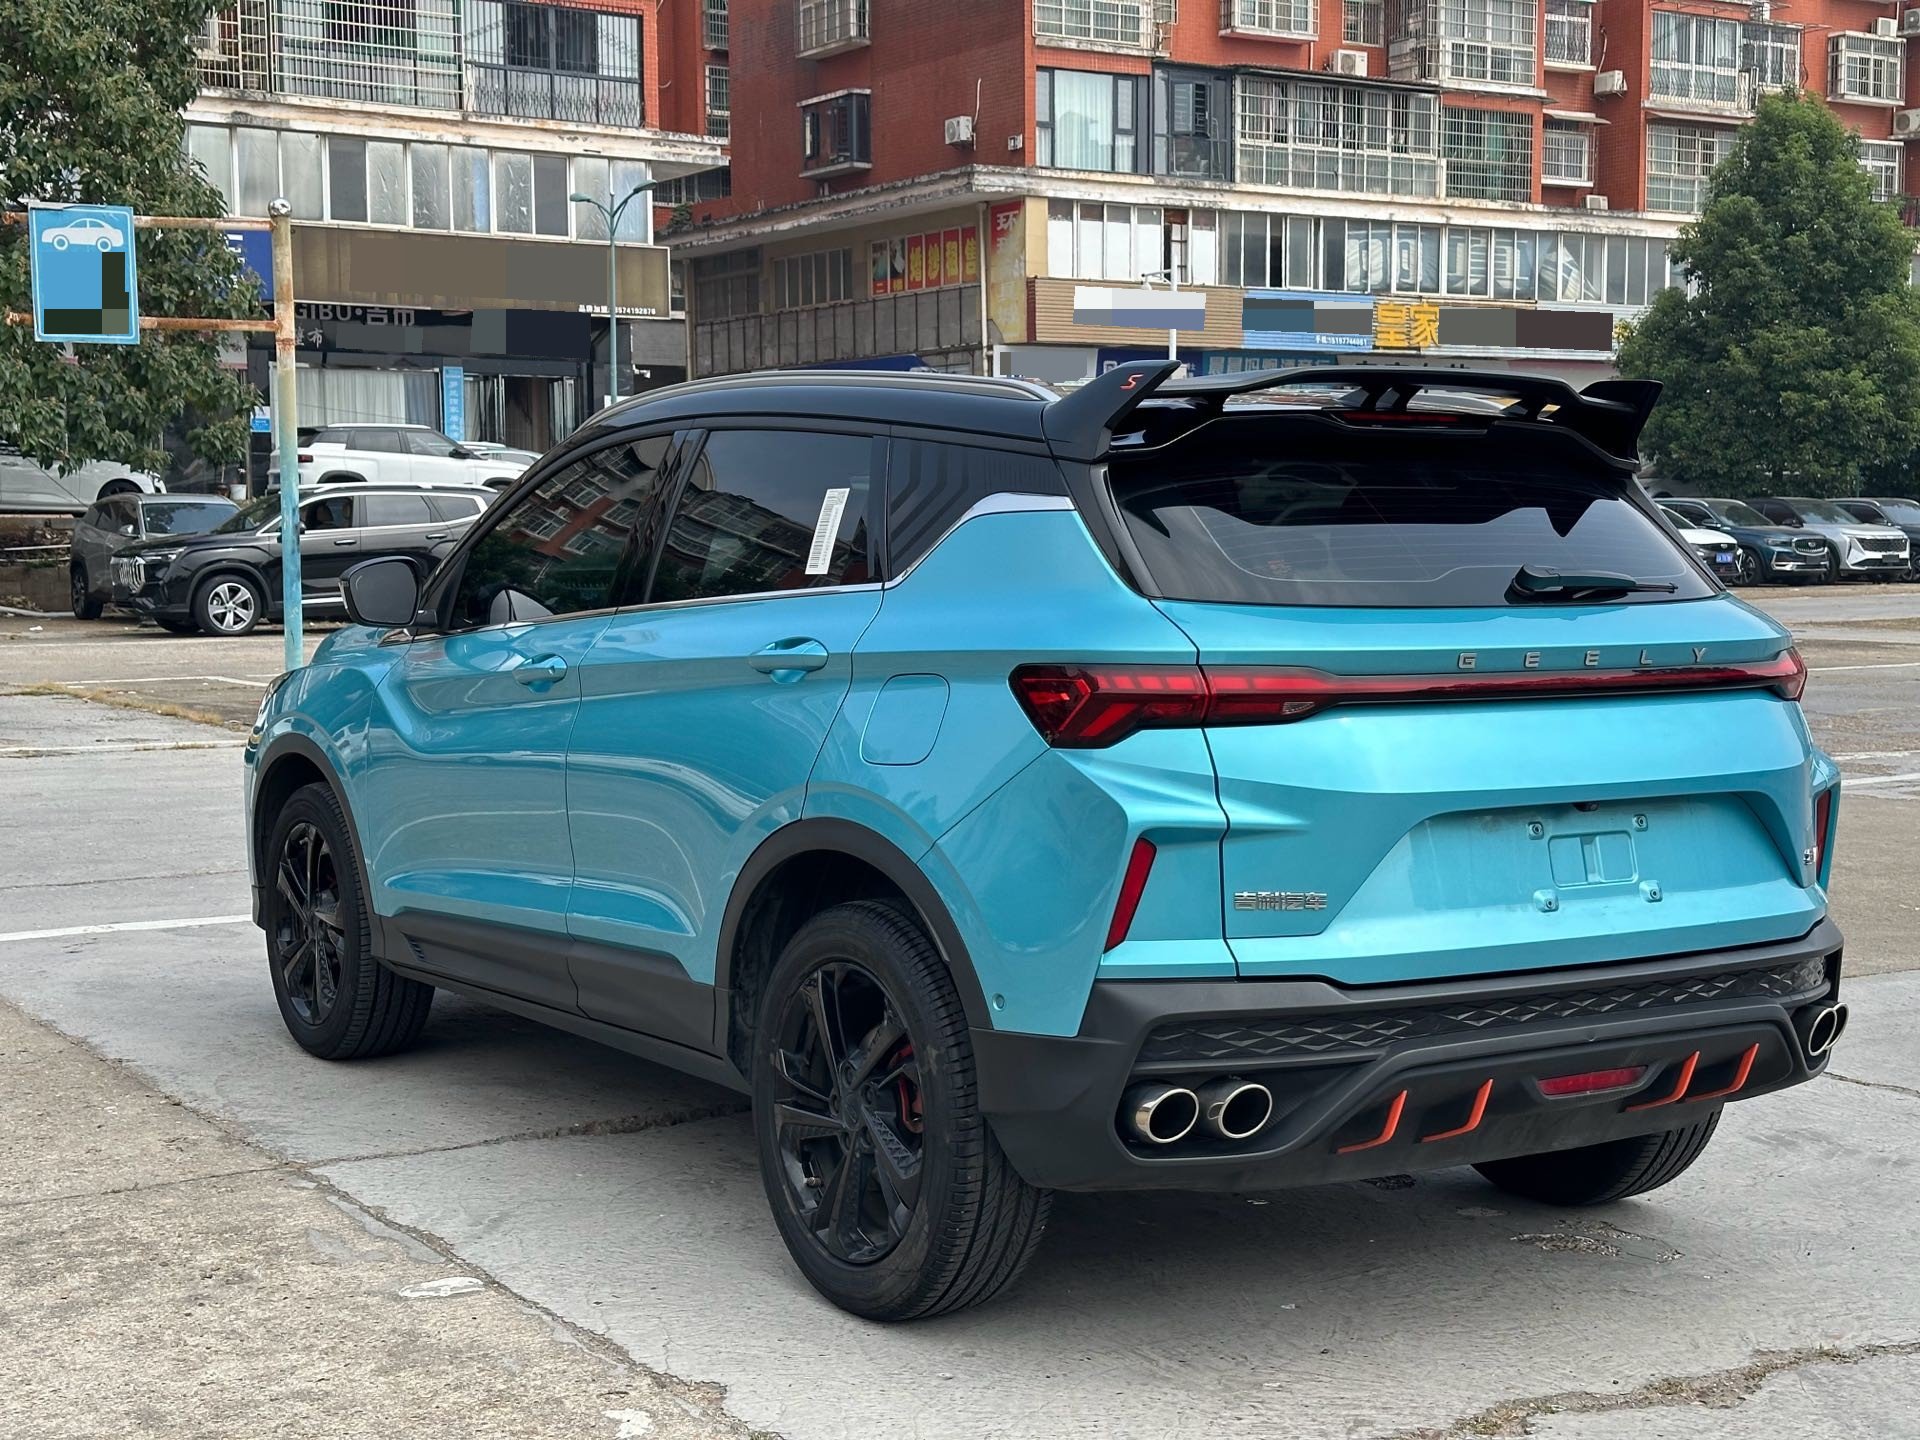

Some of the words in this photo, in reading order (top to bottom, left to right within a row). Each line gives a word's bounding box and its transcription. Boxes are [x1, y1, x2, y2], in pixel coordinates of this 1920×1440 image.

[910, 238, 977, 282] 婚纱租售
[1375, 300, 1440, 348] 皇家
[1457, 647, 1708, 669] GEELY
[1234, 891, 1328, 911] 吉利汽车
